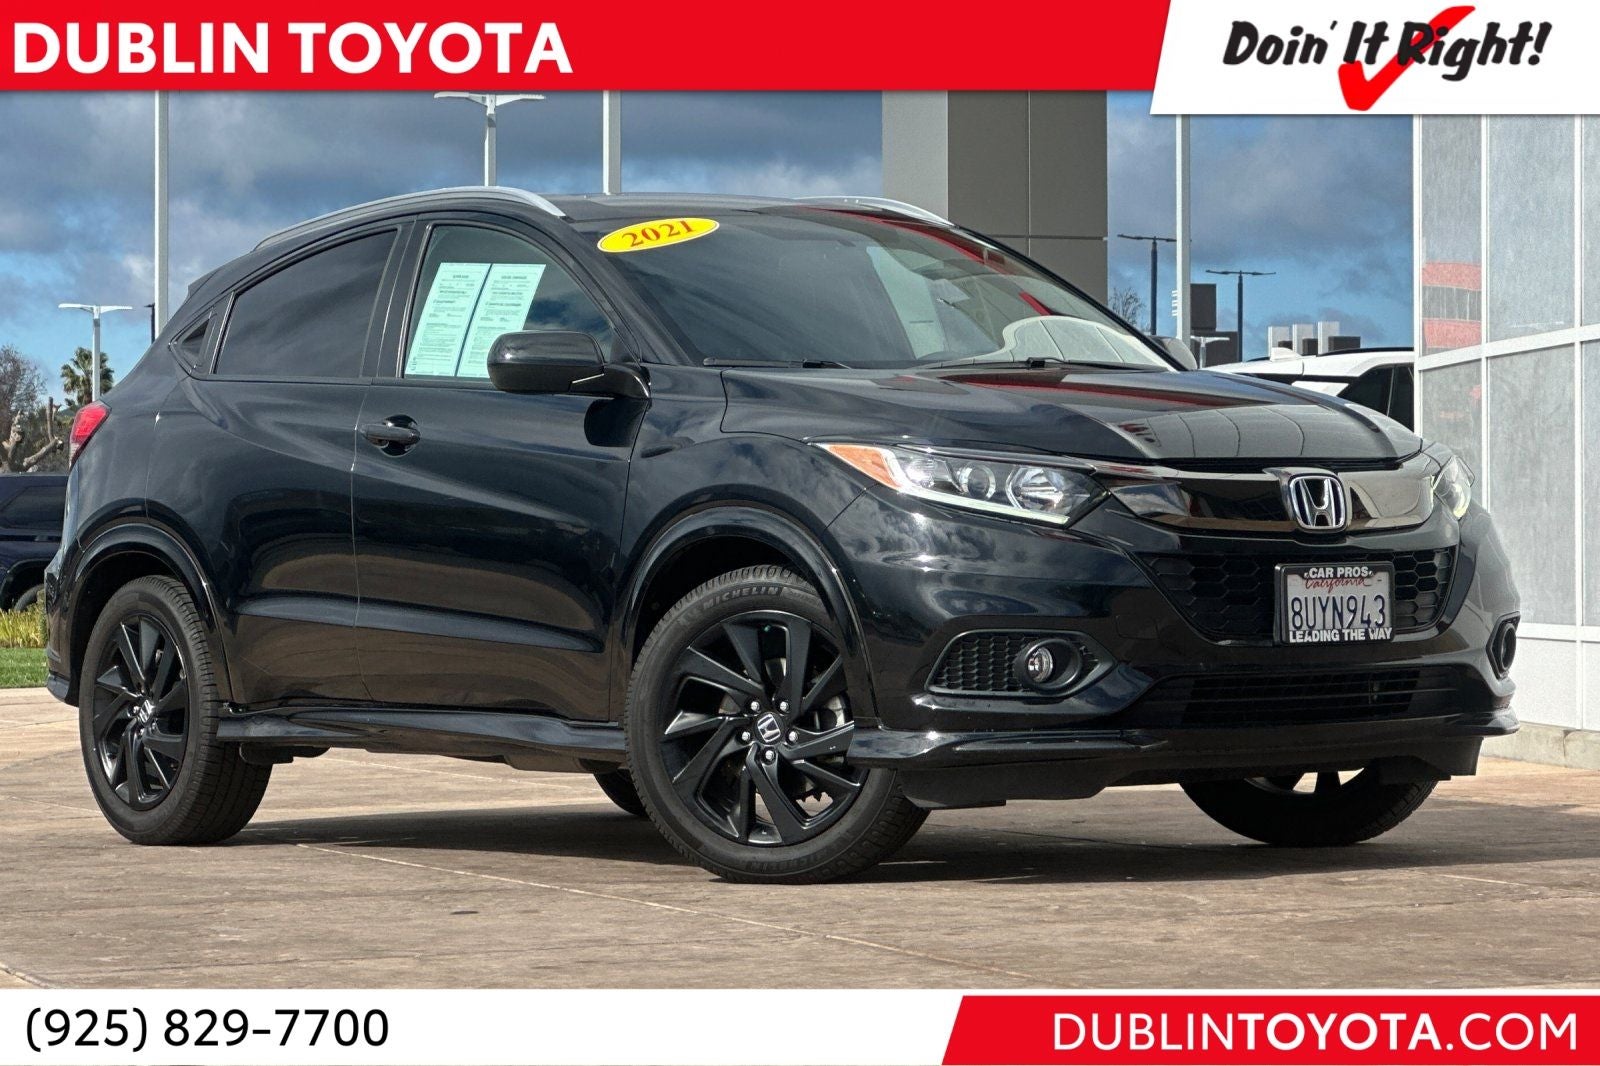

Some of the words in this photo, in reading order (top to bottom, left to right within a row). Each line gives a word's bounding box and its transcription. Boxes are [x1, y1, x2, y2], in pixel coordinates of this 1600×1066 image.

[621, 220, 695, 247] 2021
[1308, 567, 1334, 579] CAR
[1336, 566, 1369, 578] PROS
[702, 586, 779, 609] MICHELIN
[1291, 595, 1386, 630] 8UYN943
[1289, 629, 1340, 643] LEADING
[1341, 628, 1366, 641] THE
[1368, 627, 1393, 640] WAY
